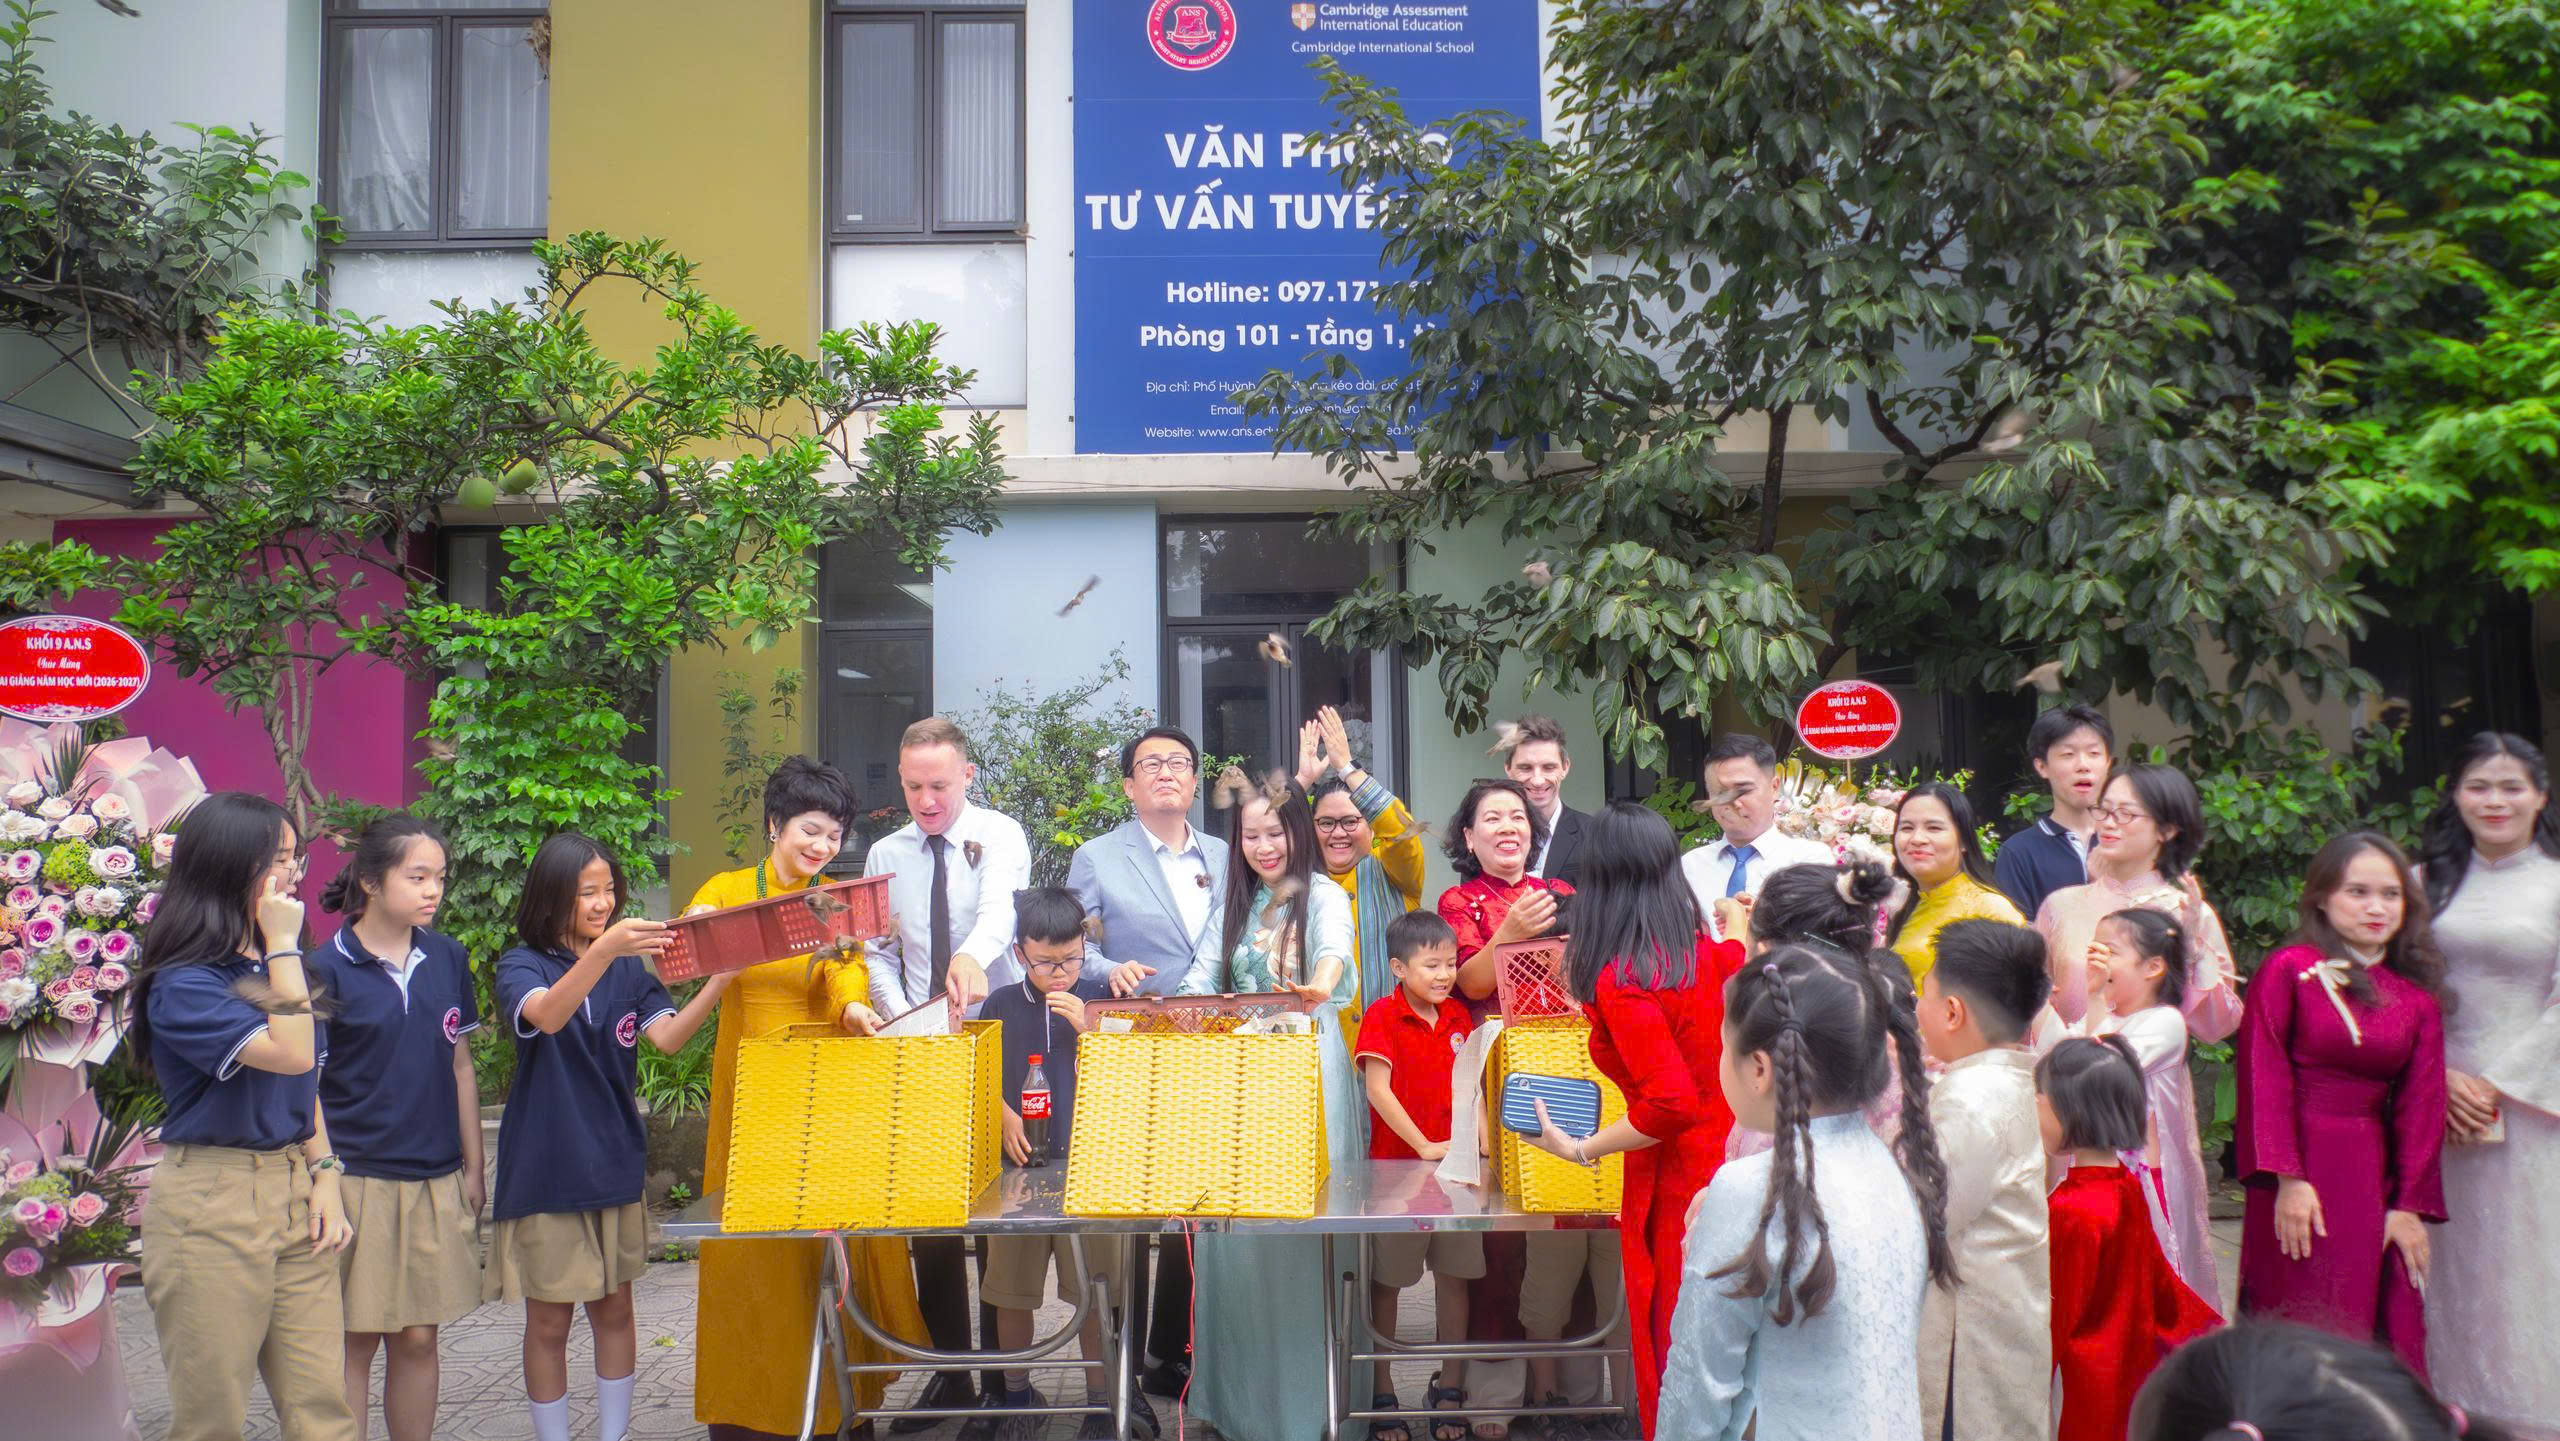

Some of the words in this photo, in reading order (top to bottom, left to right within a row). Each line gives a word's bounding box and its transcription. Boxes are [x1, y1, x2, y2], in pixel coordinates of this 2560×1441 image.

[1320, 4, 1389, 18] Cambridge
[1393, 4, 1468, 17] Assessment
[1320, 19, 1399, 31] International
[1403, 19, 1463, 31] Education
[1291, 41, 1356, 55] Cambridge
[1359, 42, 1432, 53] International
[1435, 42, 1474, 53] School
[1164, 124, 1264, 168] VĂN
[1085, 189, 1142, 231] TƯ
[1154, 177, 1254, 230] VẤN
[1167, 281, 1269, 303] Hotline:
[1141, 323, 1225, 352] Phòng
[1236, 324, 1278, 346] 101
[1306, 317, 1372, 351] Tầng
[1383, 324, 1405, 349] 1,
[1146, 381, 1166, 394] Địa
[1169, 380, 1190, 393] chỉ:
[1193, 380, 1216, 393] Phố
[1331, 379, 1352, 391] kéo
[1210, 404, 1245, 415] Email:
[1145, 426, 1194, 438] Website:
[26, 632, 53, 650] KHỐI
[55, 637, 62, 650] 9
[64, 637, 92, 650] A.N.S
[9, 672, 36, 687] GIẢNG
[37, 674, 56, 687] NĂM
[57, 676, 75, 689] HỌC
[76, 674, 93, 687] MỚI
[93, 676, 141, 688] (2026-2027)
[1827, 694, 1843, 708] KHỐI
[1844, 696, 1850, 706] 12
[1850, 695, 1867, 706] A.N.S
